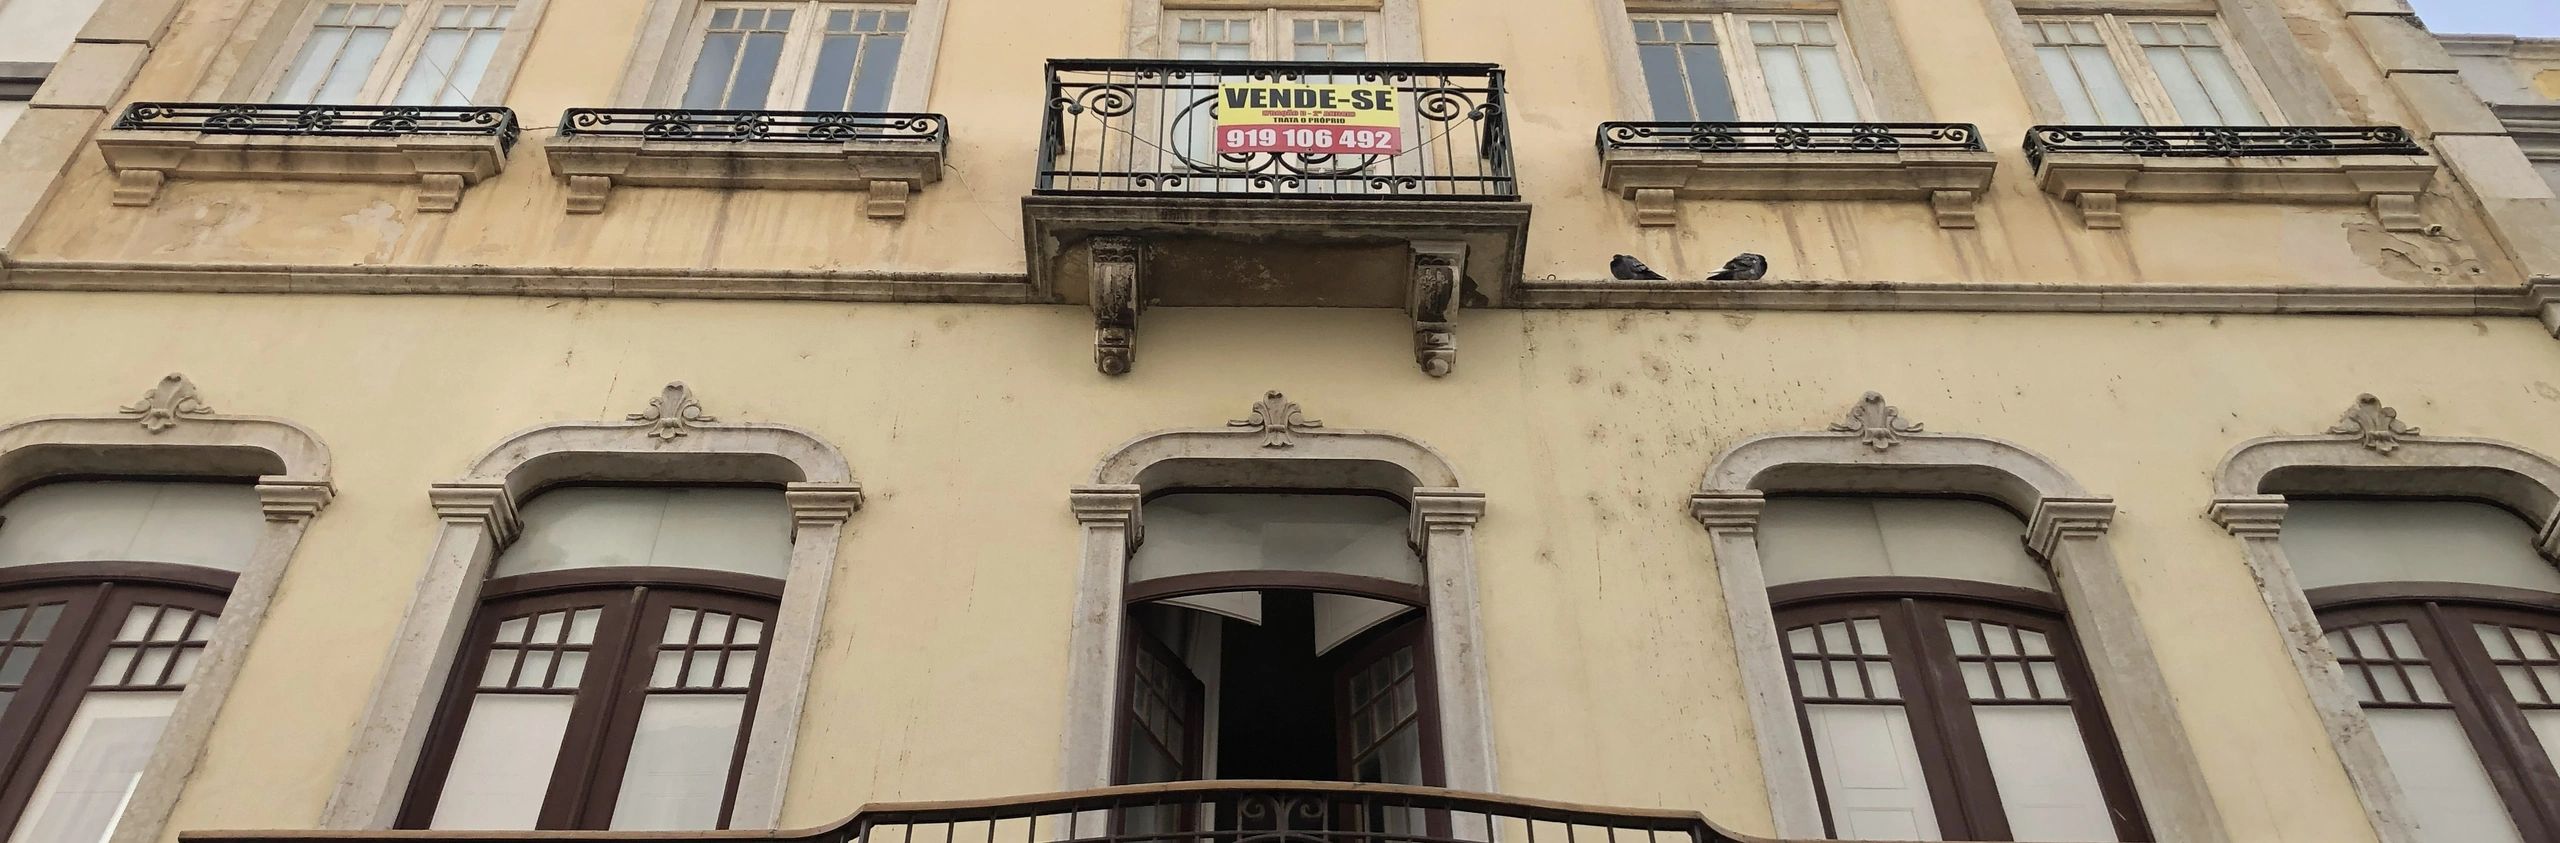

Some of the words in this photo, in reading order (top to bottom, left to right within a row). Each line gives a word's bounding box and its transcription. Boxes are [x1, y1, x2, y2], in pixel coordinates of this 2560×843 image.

[1225, 88, 1393, 111] VENDE-SE
[1308, 116, 1346, 124] PRÓPRIO
[1226, 128, 1277, 148] 919
[1283, 128, 1333, 148] 106
[1339, 129, 1392, 149] 492
